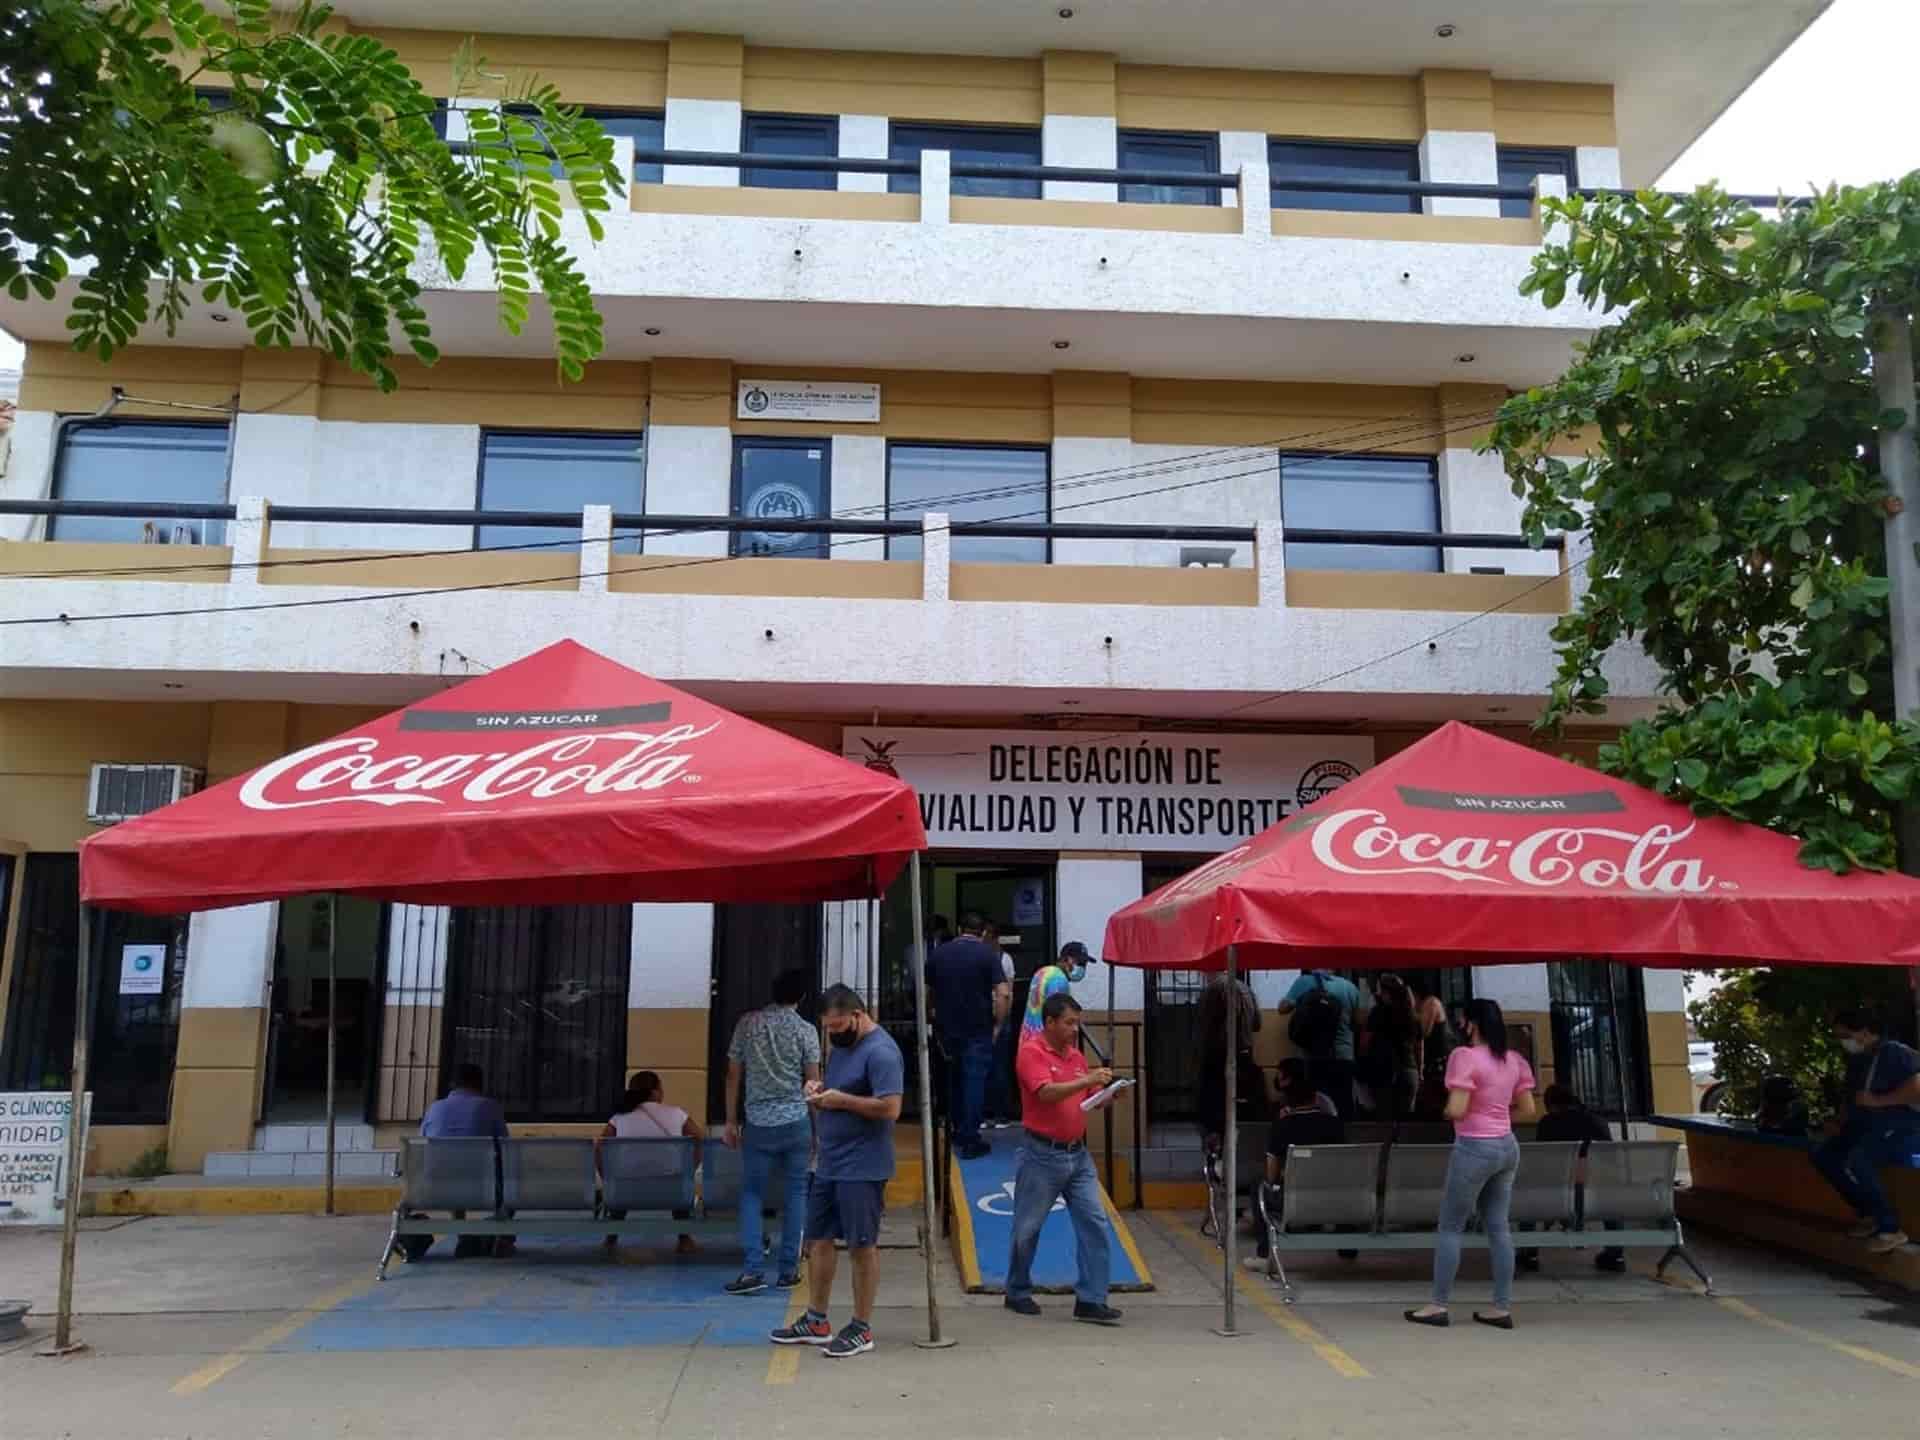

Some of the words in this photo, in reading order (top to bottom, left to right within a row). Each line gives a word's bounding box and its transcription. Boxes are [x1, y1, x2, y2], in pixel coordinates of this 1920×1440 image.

[476, 716, 509, 726] SIN
[514, 714, 598, 725] AZUCAR
[240, 719, 722, 810] Coca-Cola
[989, 740, 1174, 784] DELEGACIÓN
[1185, 747, 1222, 785] DE
[919, 793, 1057, 833] VIALIDAD
[1068, 796, 1084, 833] Y
[1455, 798, 1486, 809] SIN
[1491, 799, 1567, 809] AZUCAR
[1311, 809, 1715, 894] Coca-Cola
[10, 1097, 72, 1116] CLÍNICOS
